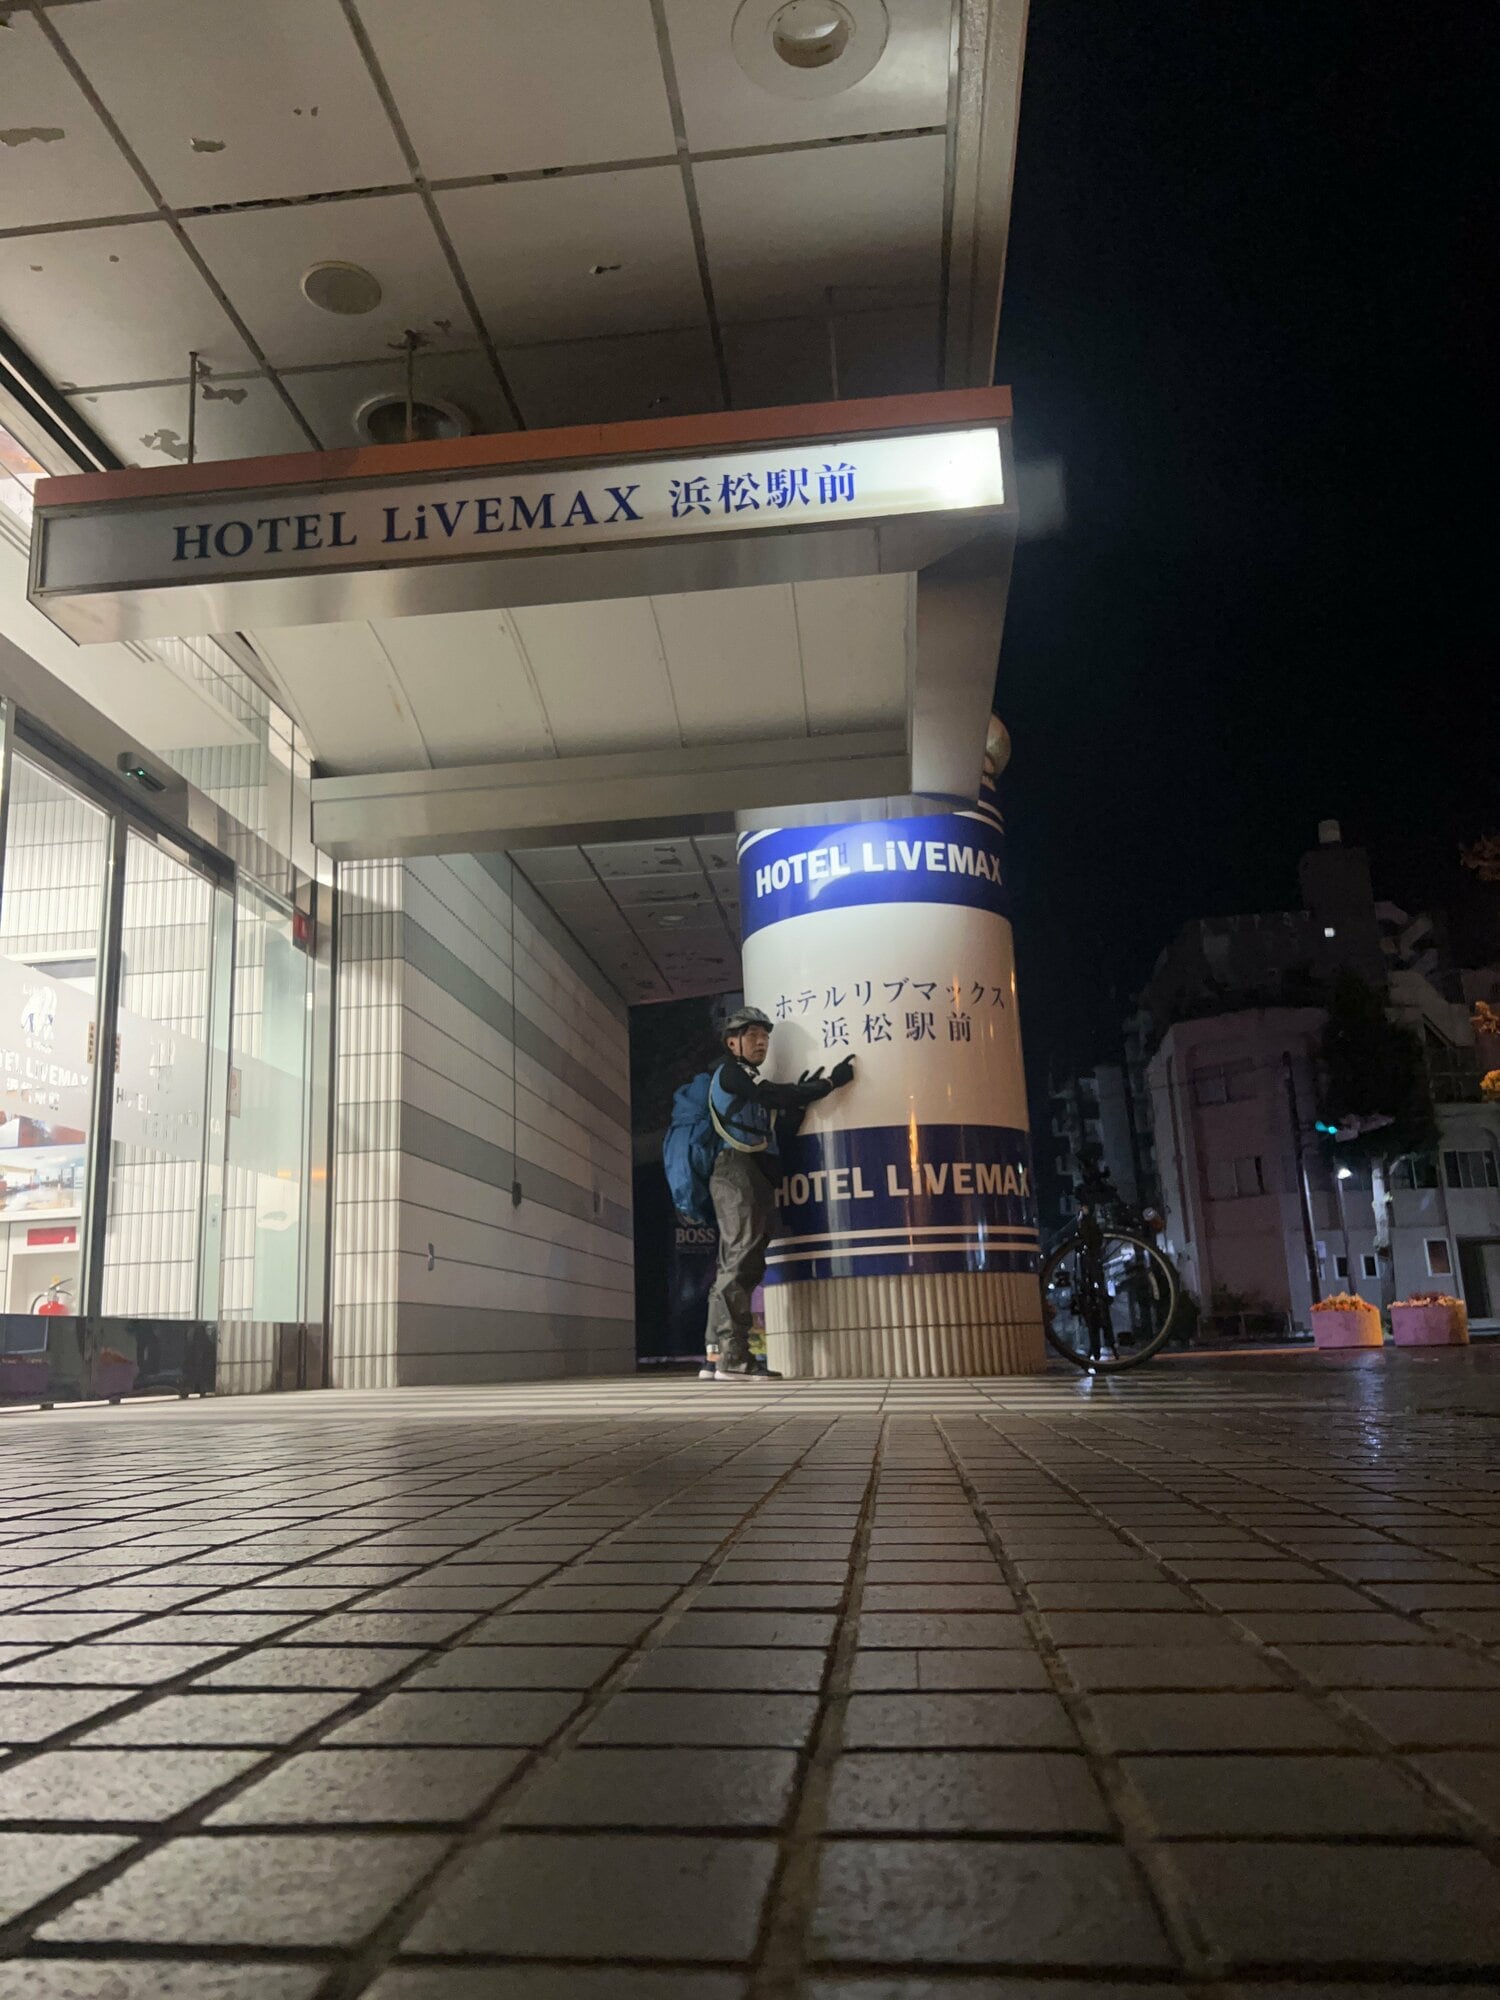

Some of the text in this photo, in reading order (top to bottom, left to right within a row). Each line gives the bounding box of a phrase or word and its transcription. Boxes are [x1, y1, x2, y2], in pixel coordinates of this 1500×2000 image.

[667, 462, 858, 518] 浜松駅前
[172, 485, 644, 561] HOTEL LiVEMAX
[755, 841, 1003, 898] HOTEL LiVEMAX
[775, 977, 1006, 1019] ホテルリブマックス
[821, 1011, 973, 1048] 浜松駅前
[774, 1166, 874, 1208] HOTEL
[675, 1228, 717, 1243] BOSS
